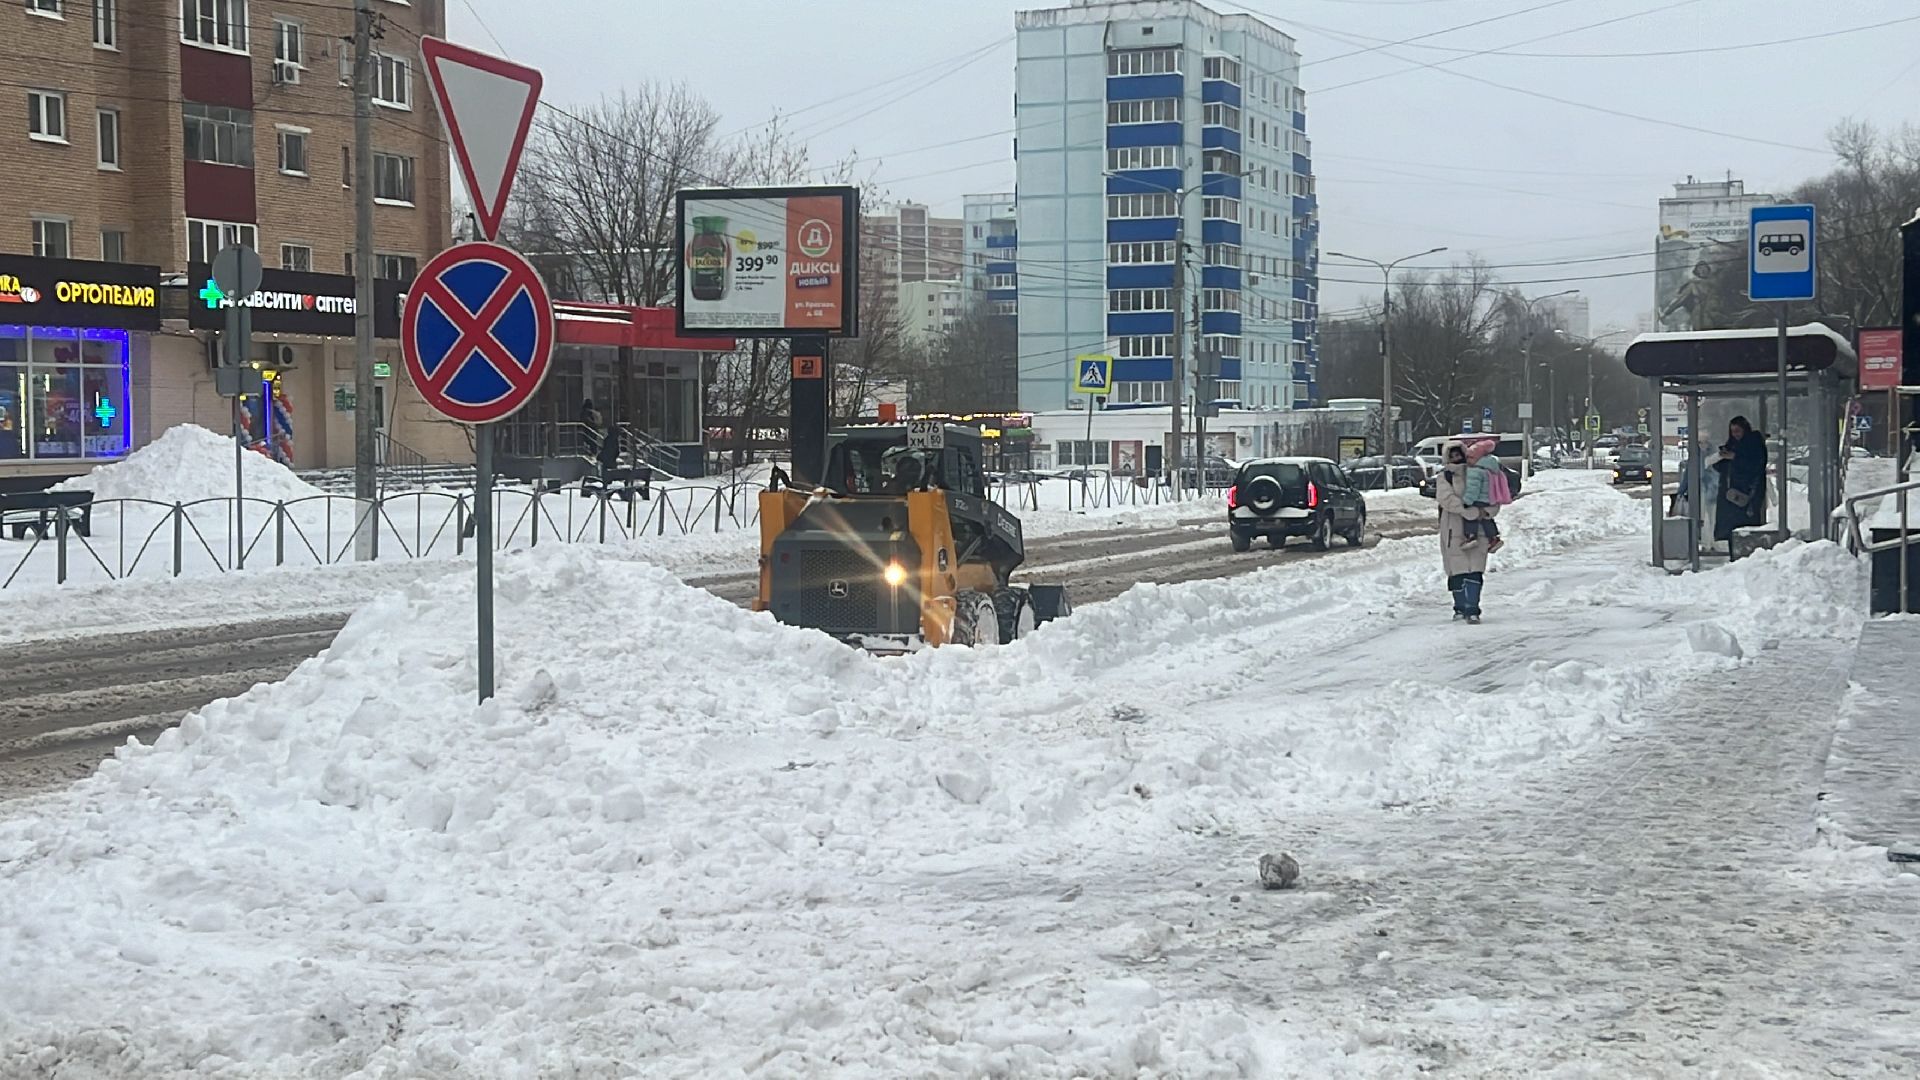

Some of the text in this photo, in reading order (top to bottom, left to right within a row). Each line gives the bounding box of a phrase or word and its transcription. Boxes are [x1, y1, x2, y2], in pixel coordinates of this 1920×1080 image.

[735, 254, 778, 272] 399 90
[55, 281, 154, 308] ОРТОПЕДИЯ
[911, 422, 940, 434] 2376
[930, 435, 941, 445] 50
